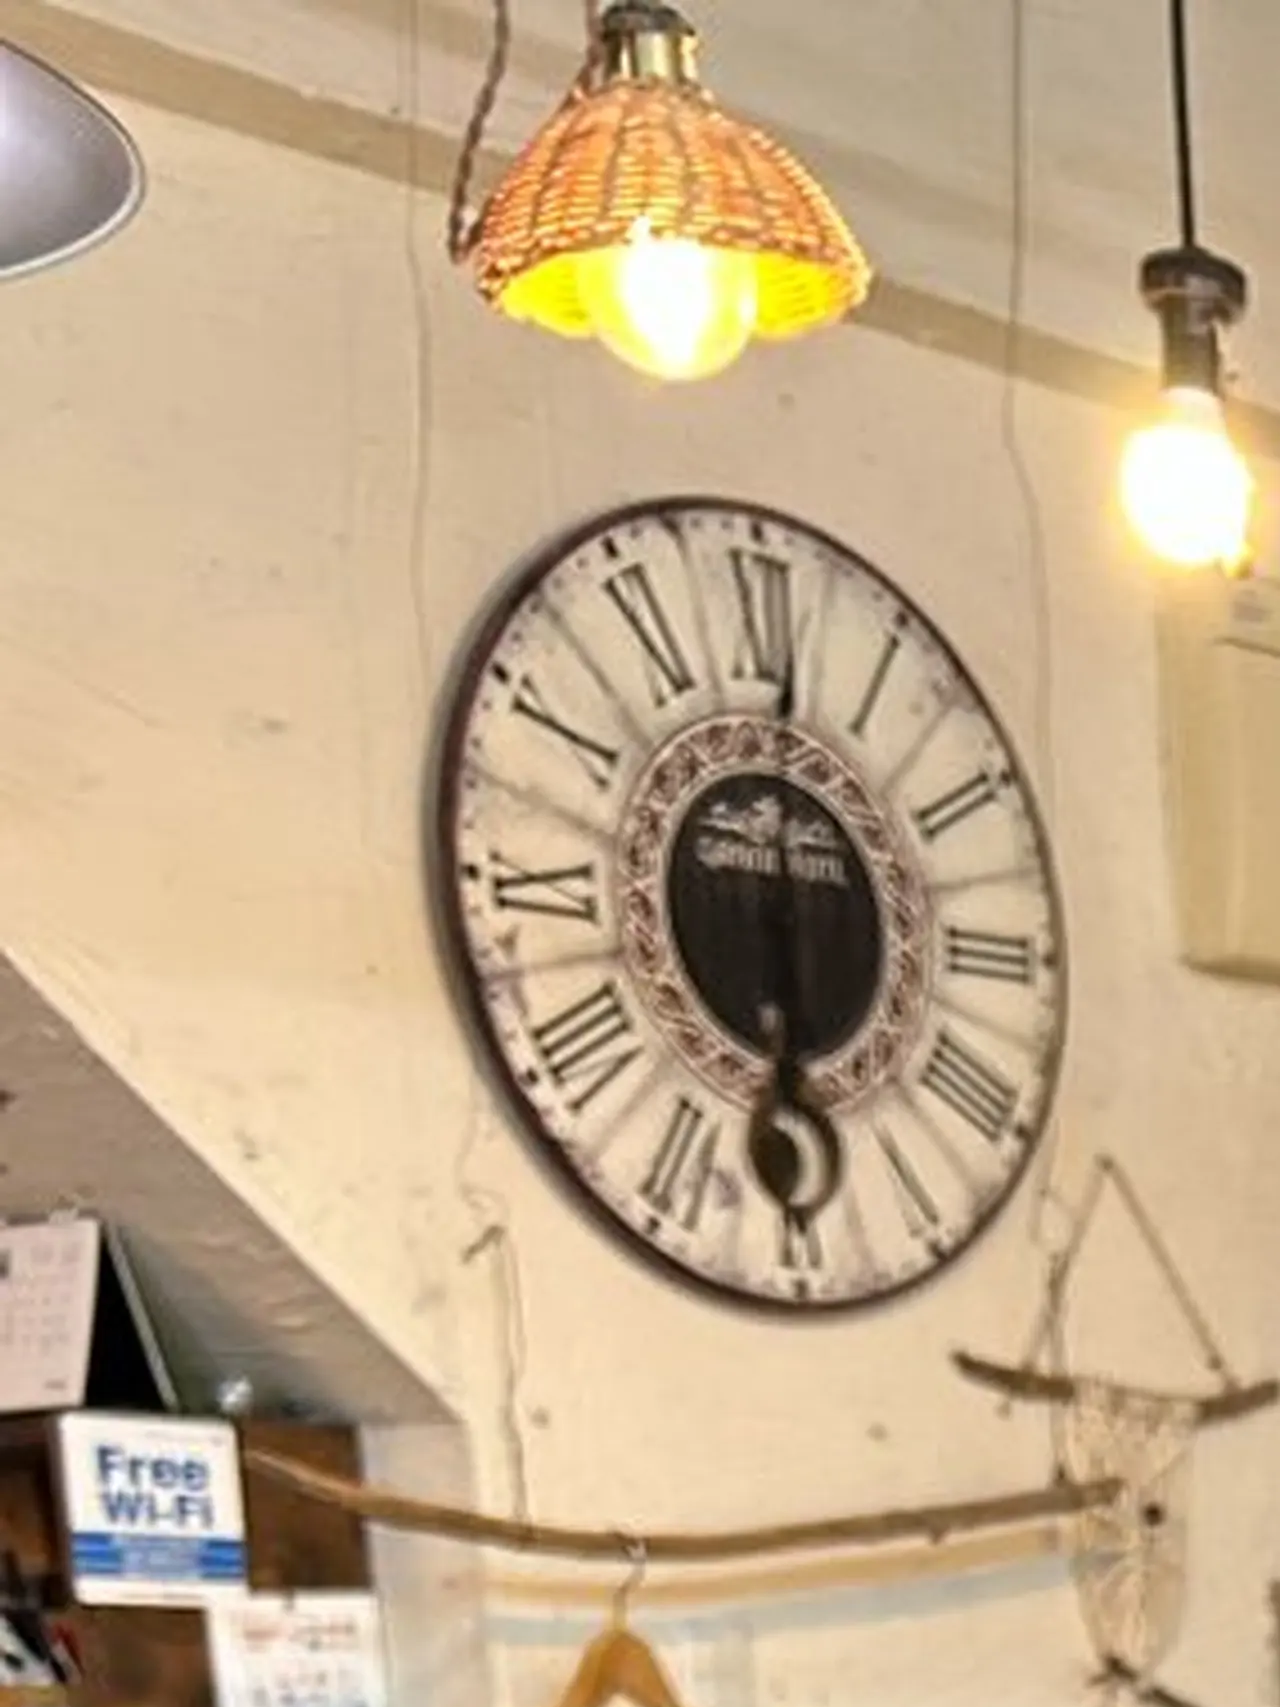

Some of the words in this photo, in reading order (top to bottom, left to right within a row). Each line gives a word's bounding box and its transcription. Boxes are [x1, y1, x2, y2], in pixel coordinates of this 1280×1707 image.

[600, 562, 697, 709] XI
[510, 672, 620, 789] X
[912, 769, 997, 842] II
[488, 850, 600, 924] IX
[944, 923, 1034, 985] III
[532, 981, 645, 1111] VIII
[918, 1025, 1020, 1143] IIII
[637, 1096, 723, 1232] VII
[96, 1444, 210, 1493] Free
